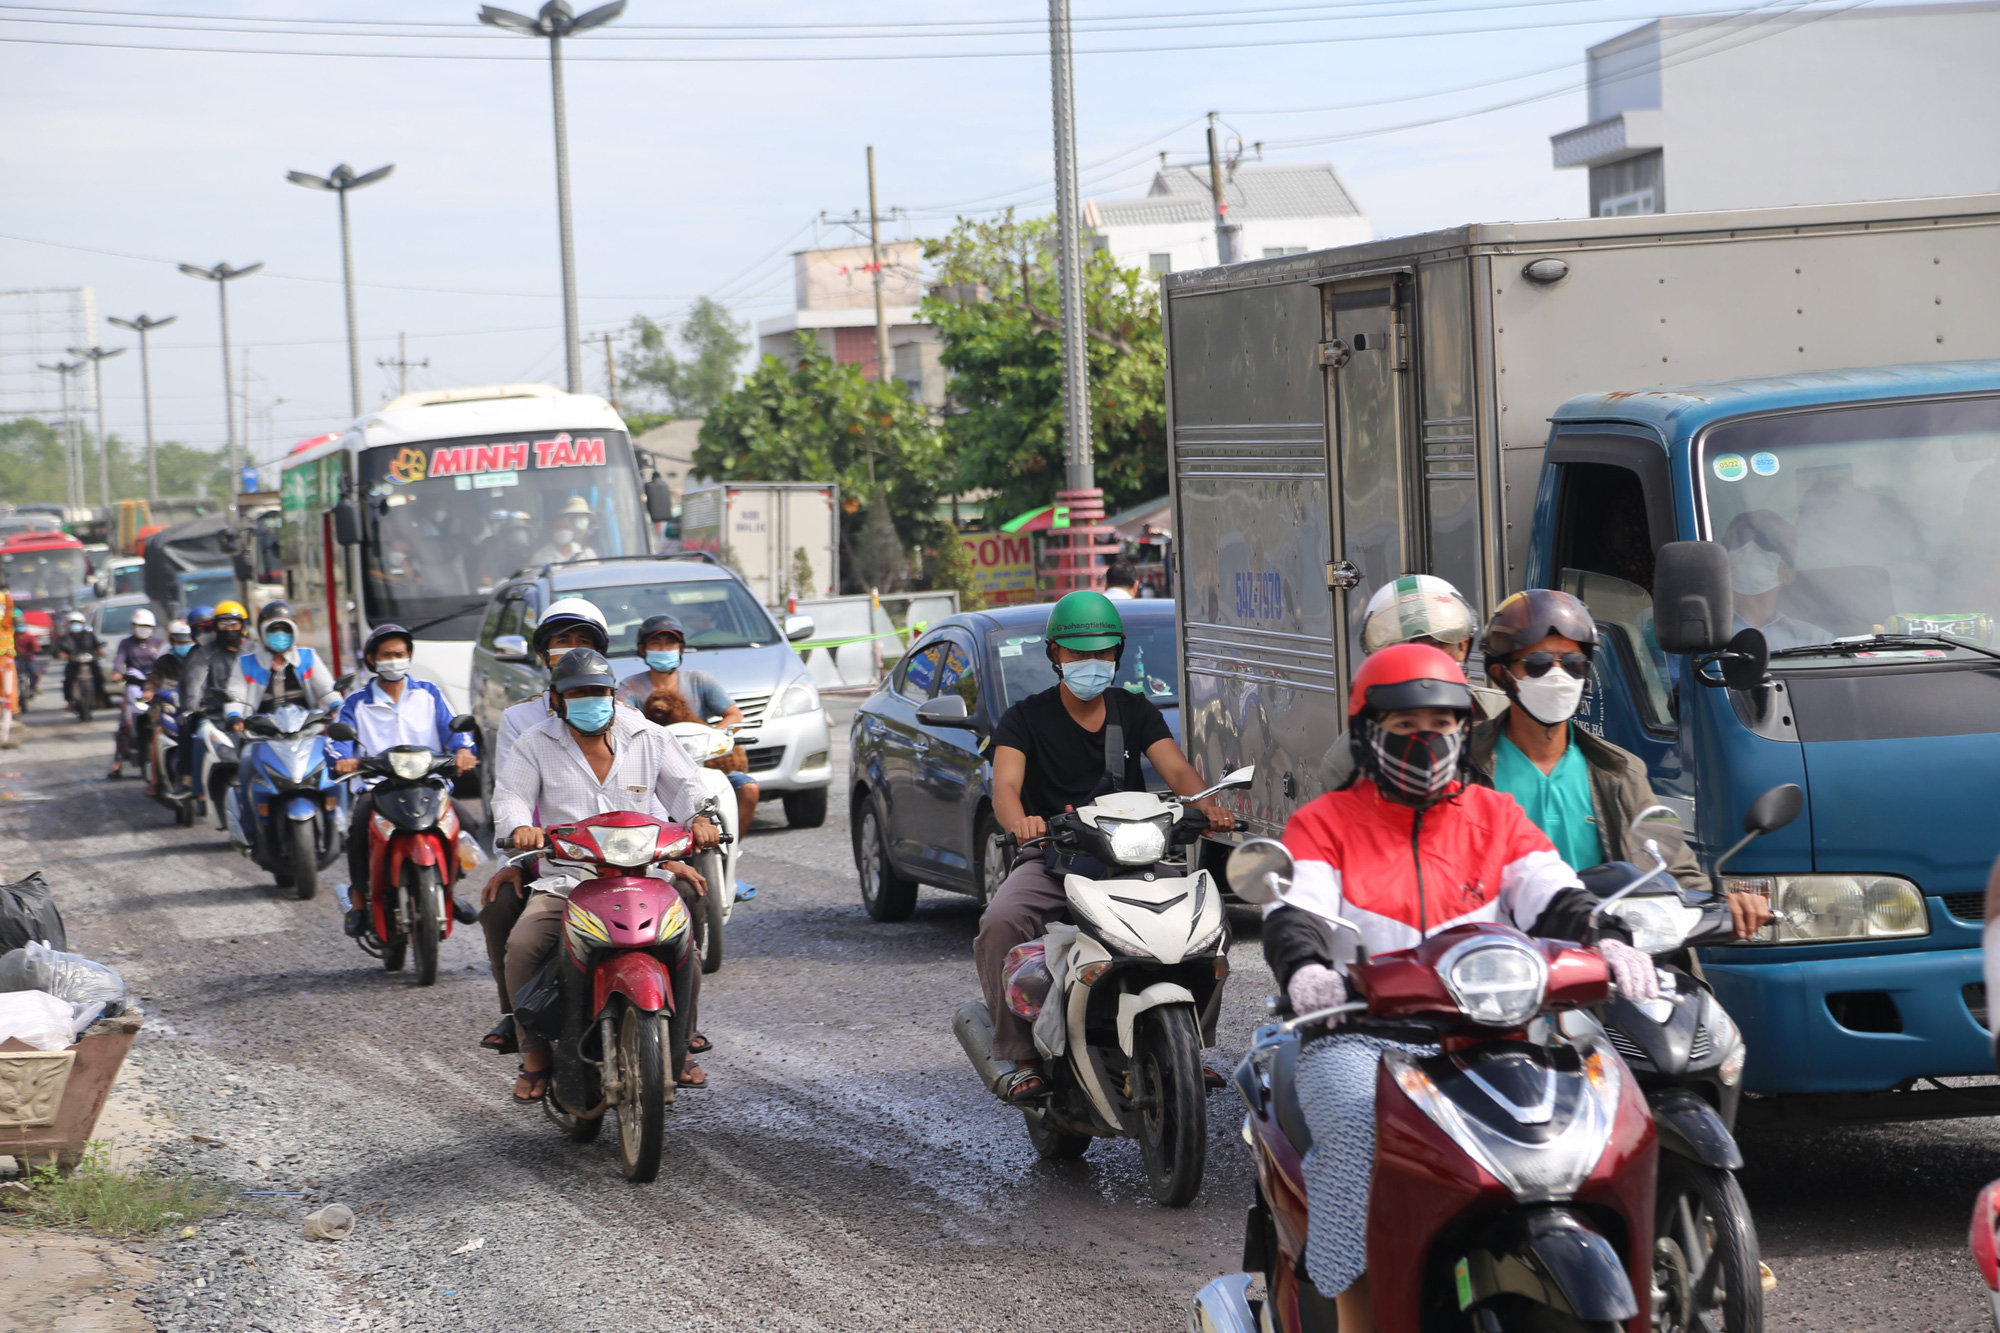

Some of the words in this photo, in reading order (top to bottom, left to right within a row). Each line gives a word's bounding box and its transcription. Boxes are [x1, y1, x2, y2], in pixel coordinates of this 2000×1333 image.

[428, 442, 529, 477] MINH
[533, 432, 606, 469] TÂM
[1235, 571, 1282, 620] 54Z-7979
